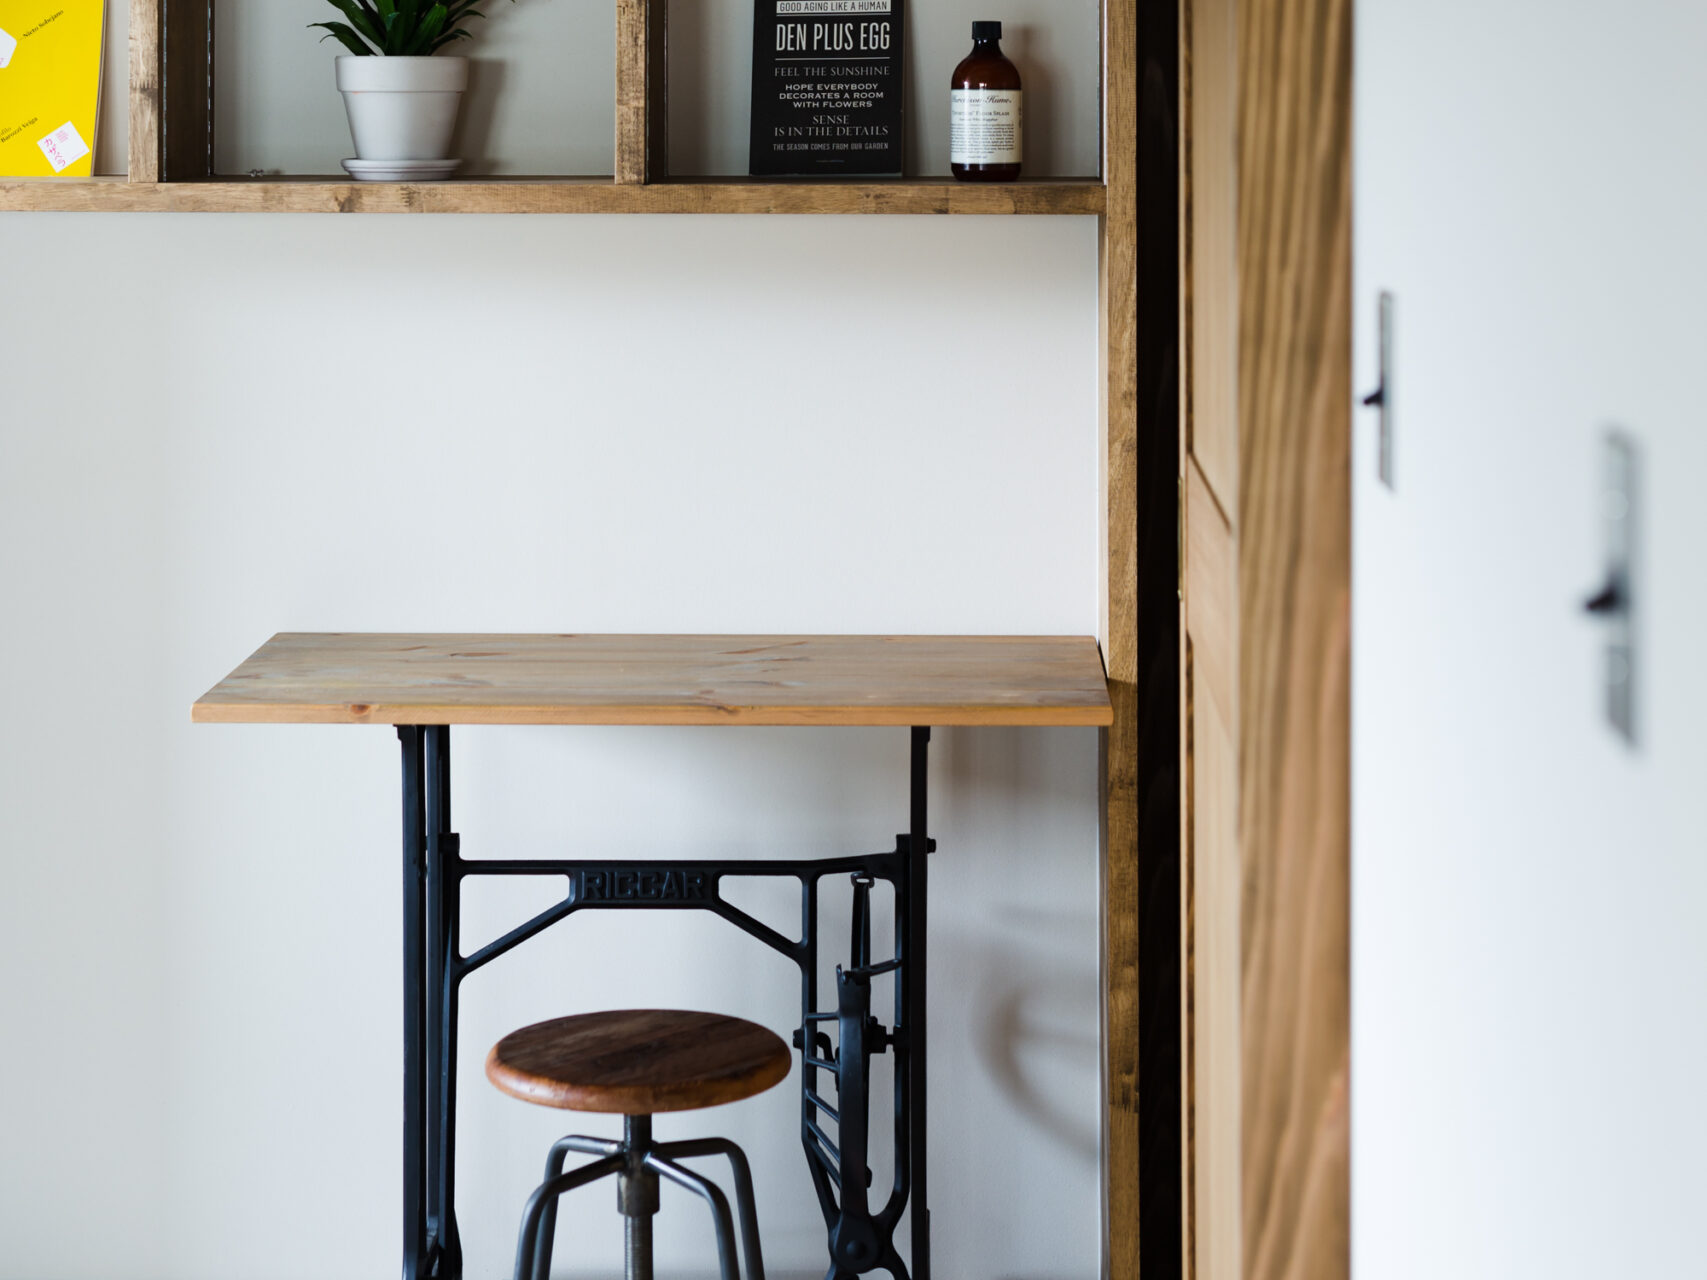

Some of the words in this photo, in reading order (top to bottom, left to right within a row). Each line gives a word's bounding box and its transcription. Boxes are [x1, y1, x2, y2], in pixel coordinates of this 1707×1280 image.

[780, 2, 802, 12] GOOD
[804, 2, 829, 11] AGING
[831, 2, 848, 11] LIKE
[851, 2, 856, 11] A
[858, 1, 887, 10] HUMAN
[776, 24, 807, 51] DEN
[813, 23, 854, 51] PLUS
[860, 22, 890, 50] EGG
[775, 67, 800, 77] FEEL
[804, 67, 827, 76] THE
[830, 66, 890, 76] SUNSHINE
[817, 83, 879, 91] EVERYBODY
[779, 92, 840, 100] DECORATES
[813, 115, 849, 125] SENSE
[775, 127, 785, 137] IS
[789, 127, 802, 137] IN
[805, 127, 833, 137] THE
[836, 126, 889, 136] DETAILS
[810, 143, 830, 151] COMES
[581, 871, 704, 899] RICCAR
